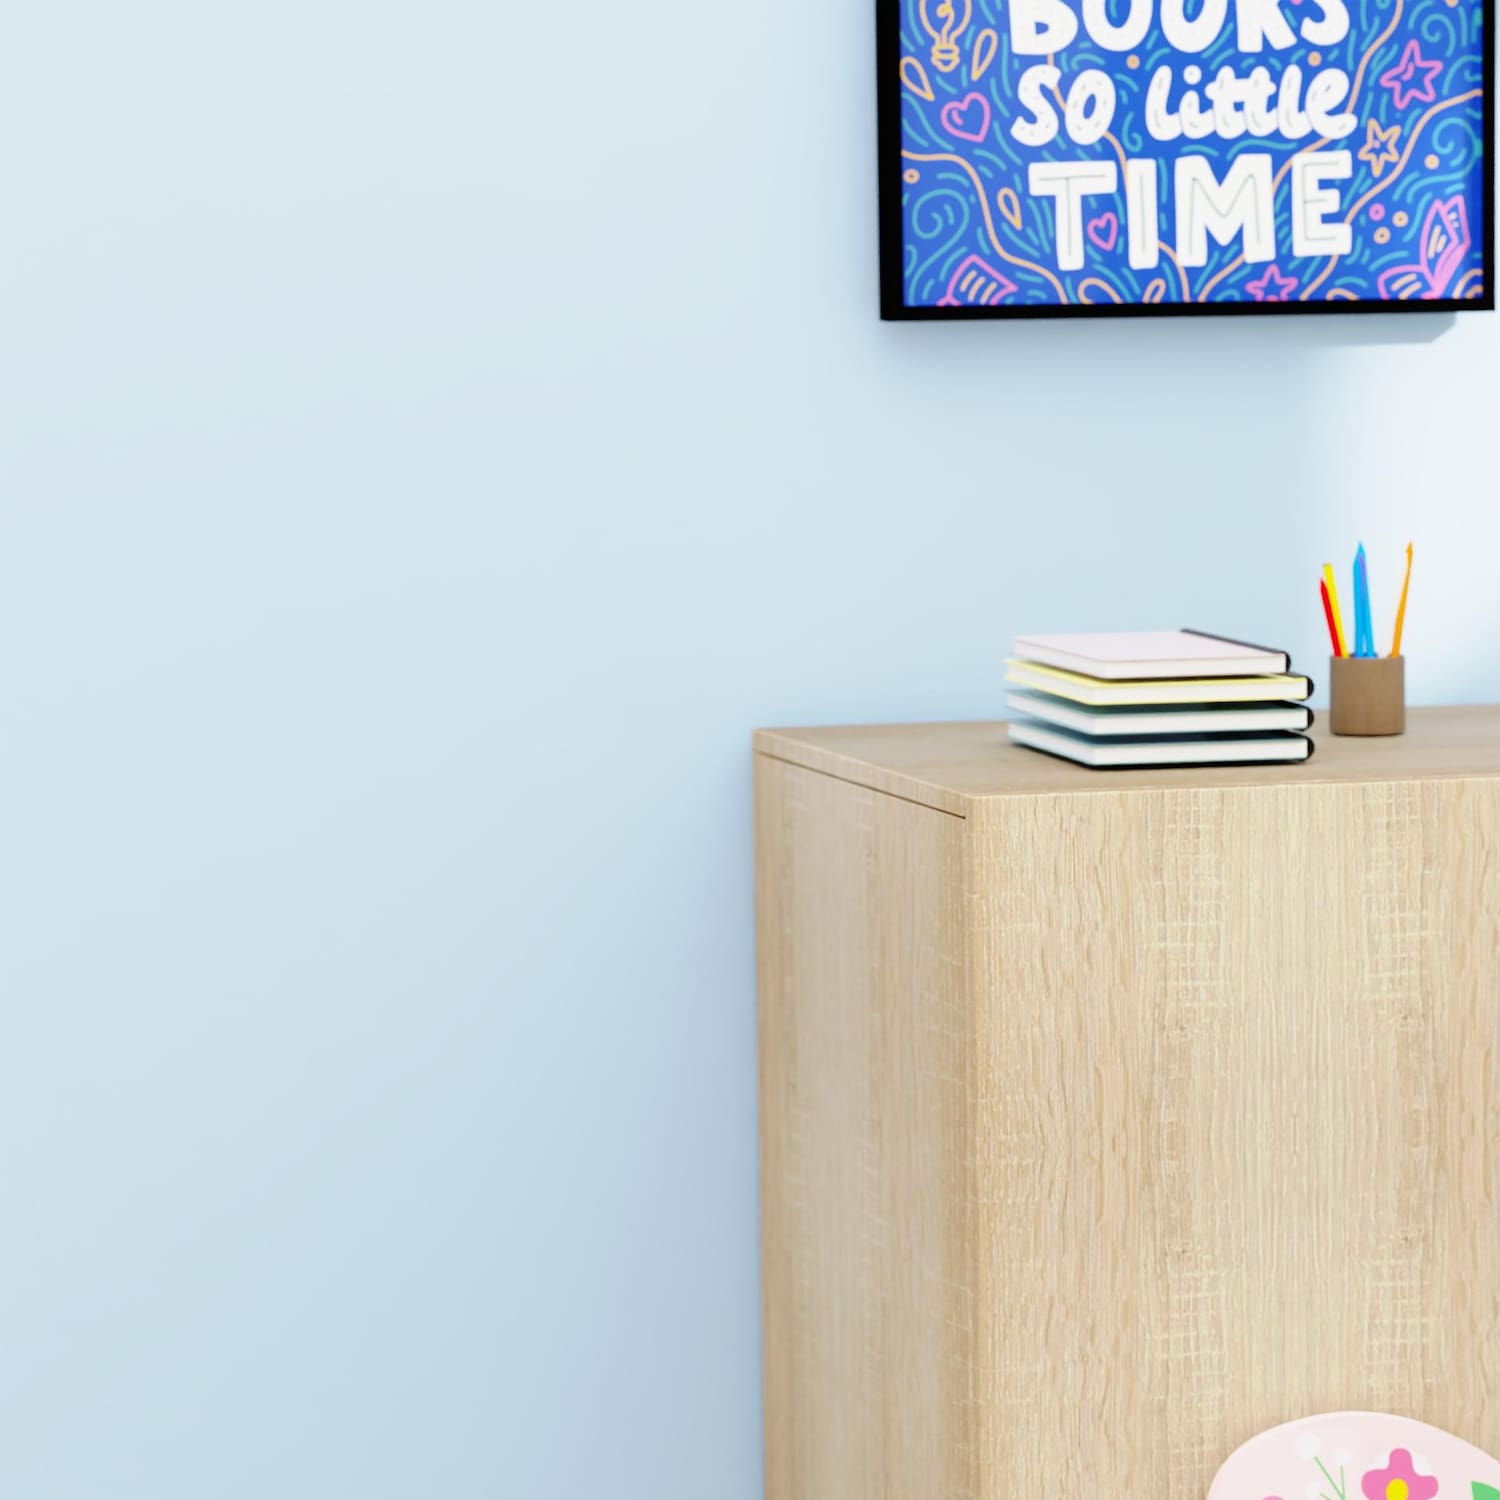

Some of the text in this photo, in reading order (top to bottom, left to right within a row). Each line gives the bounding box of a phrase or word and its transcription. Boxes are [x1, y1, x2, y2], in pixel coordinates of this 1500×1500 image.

[1009, 0, 1350, 55] BOOKS
[1144, 64, 1358, 142] little
[1028, 150, 1352, 271] TIME
